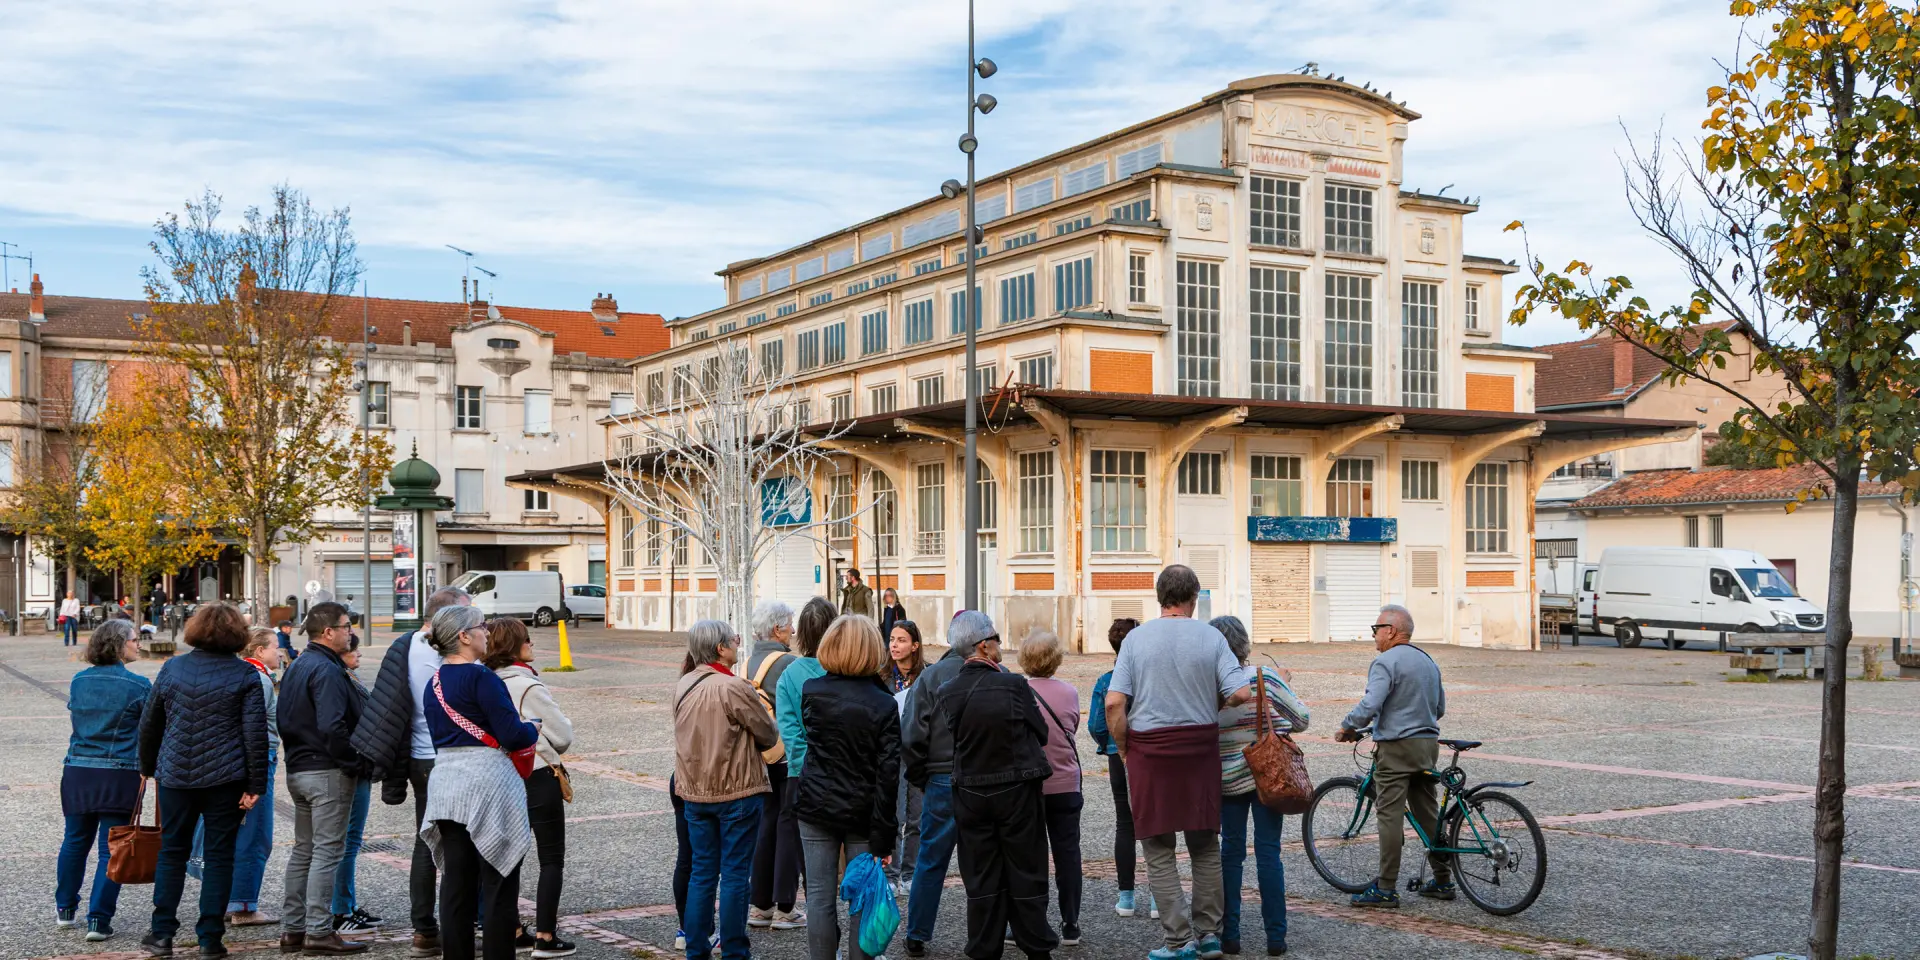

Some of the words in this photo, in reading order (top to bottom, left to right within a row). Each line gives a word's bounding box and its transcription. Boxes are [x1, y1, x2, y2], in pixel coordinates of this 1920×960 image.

[328, 534, 340, 543] Le
[342, 533, 376, 543] Fouril
[378, 534, 389, 543] de
